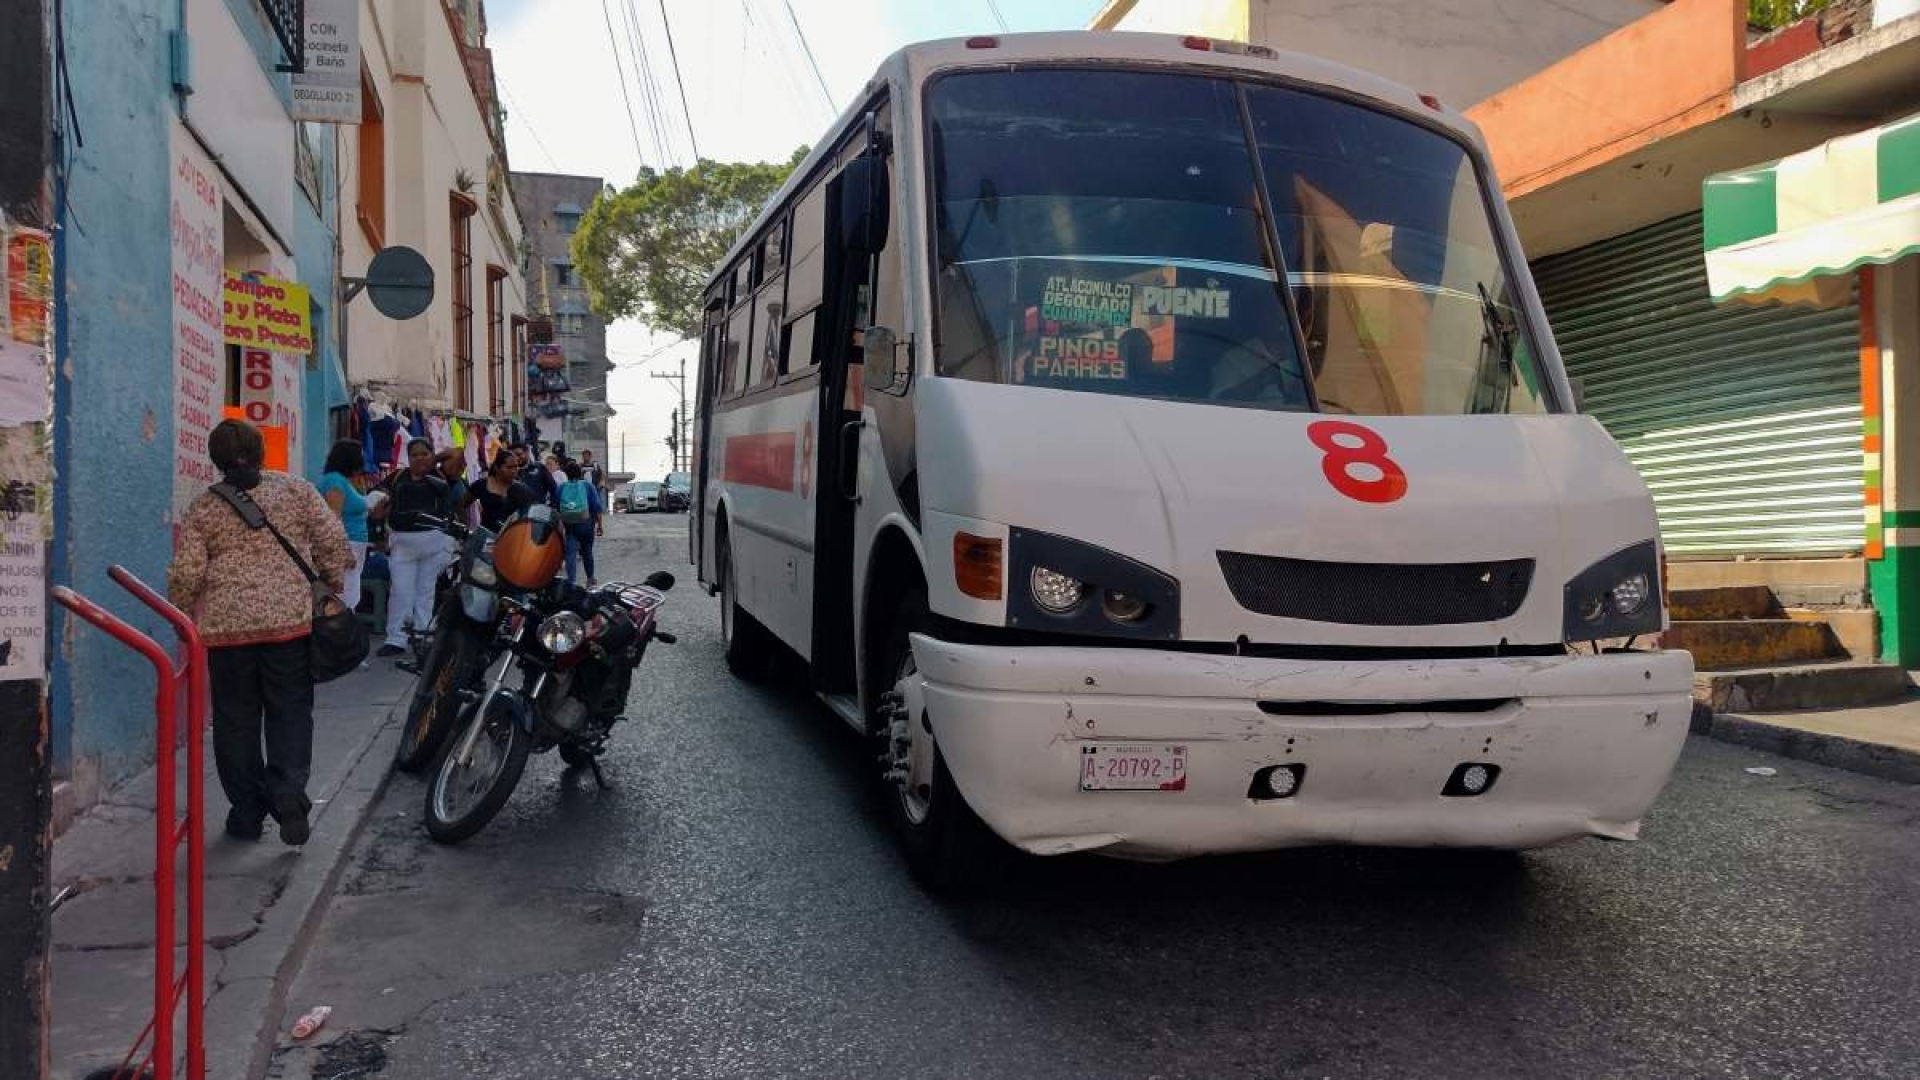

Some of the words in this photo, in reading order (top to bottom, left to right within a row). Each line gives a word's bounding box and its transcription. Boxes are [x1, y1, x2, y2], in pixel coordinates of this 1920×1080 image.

[310, 23, 337, 36] CON
[236, 303, 249, 320] y
[1044, 292, 1130, 312] DEGOLLADO
[1142, 285, 1230, 318] PUENTE
[1040, 336, 1119, 359] PINOS
[801, 416, 813, 500] 8
[1306, 420, 1408, 503] 8
[1085, 757, 1184, 779] A-20792-P
